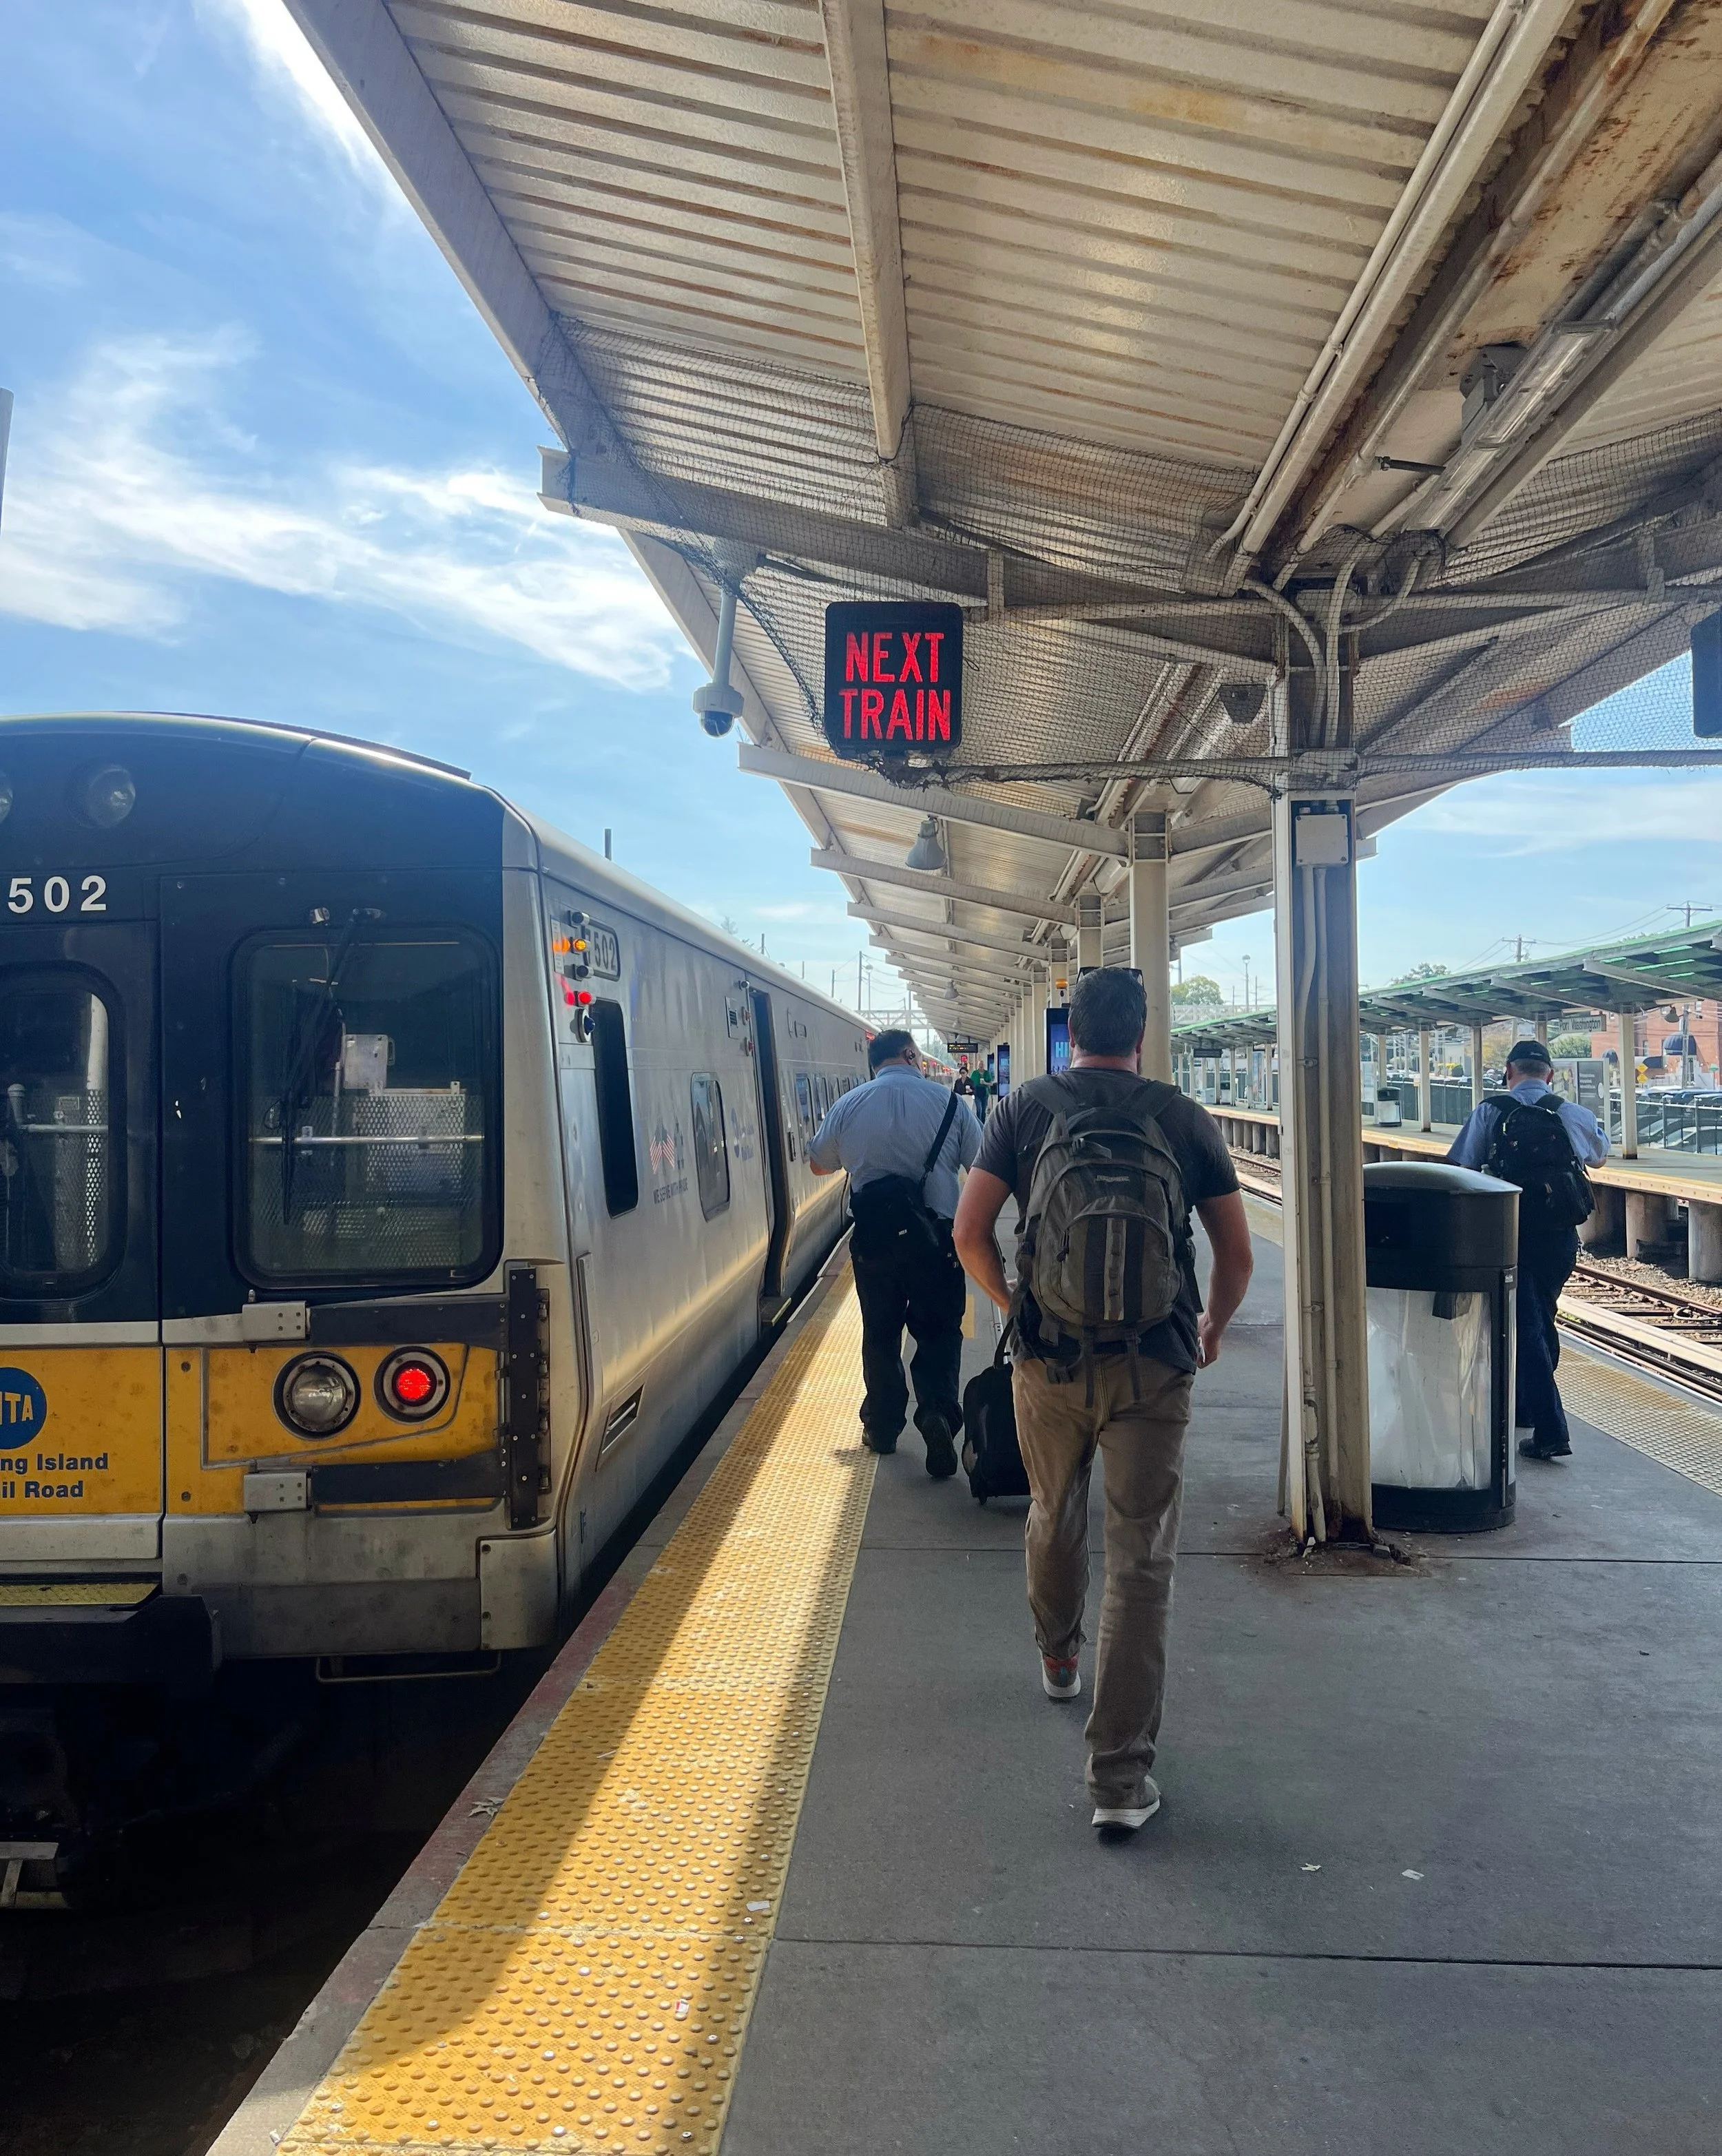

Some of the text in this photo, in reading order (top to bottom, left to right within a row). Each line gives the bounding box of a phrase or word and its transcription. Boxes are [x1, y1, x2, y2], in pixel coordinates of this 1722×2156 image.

[844, 631, 945, 683] NEXT
[838, 689, 951, 741] TRAIN
[8, 874, 107, 914] 502
[1571, 1018, 1601, 1032] Washington
[1055, 1041, 1070, 1058] HI
[0, 1391, 33, 1425] TA
[37, 1452, 109, 1471] Island
[24, 1480, 84, 1499] Road
